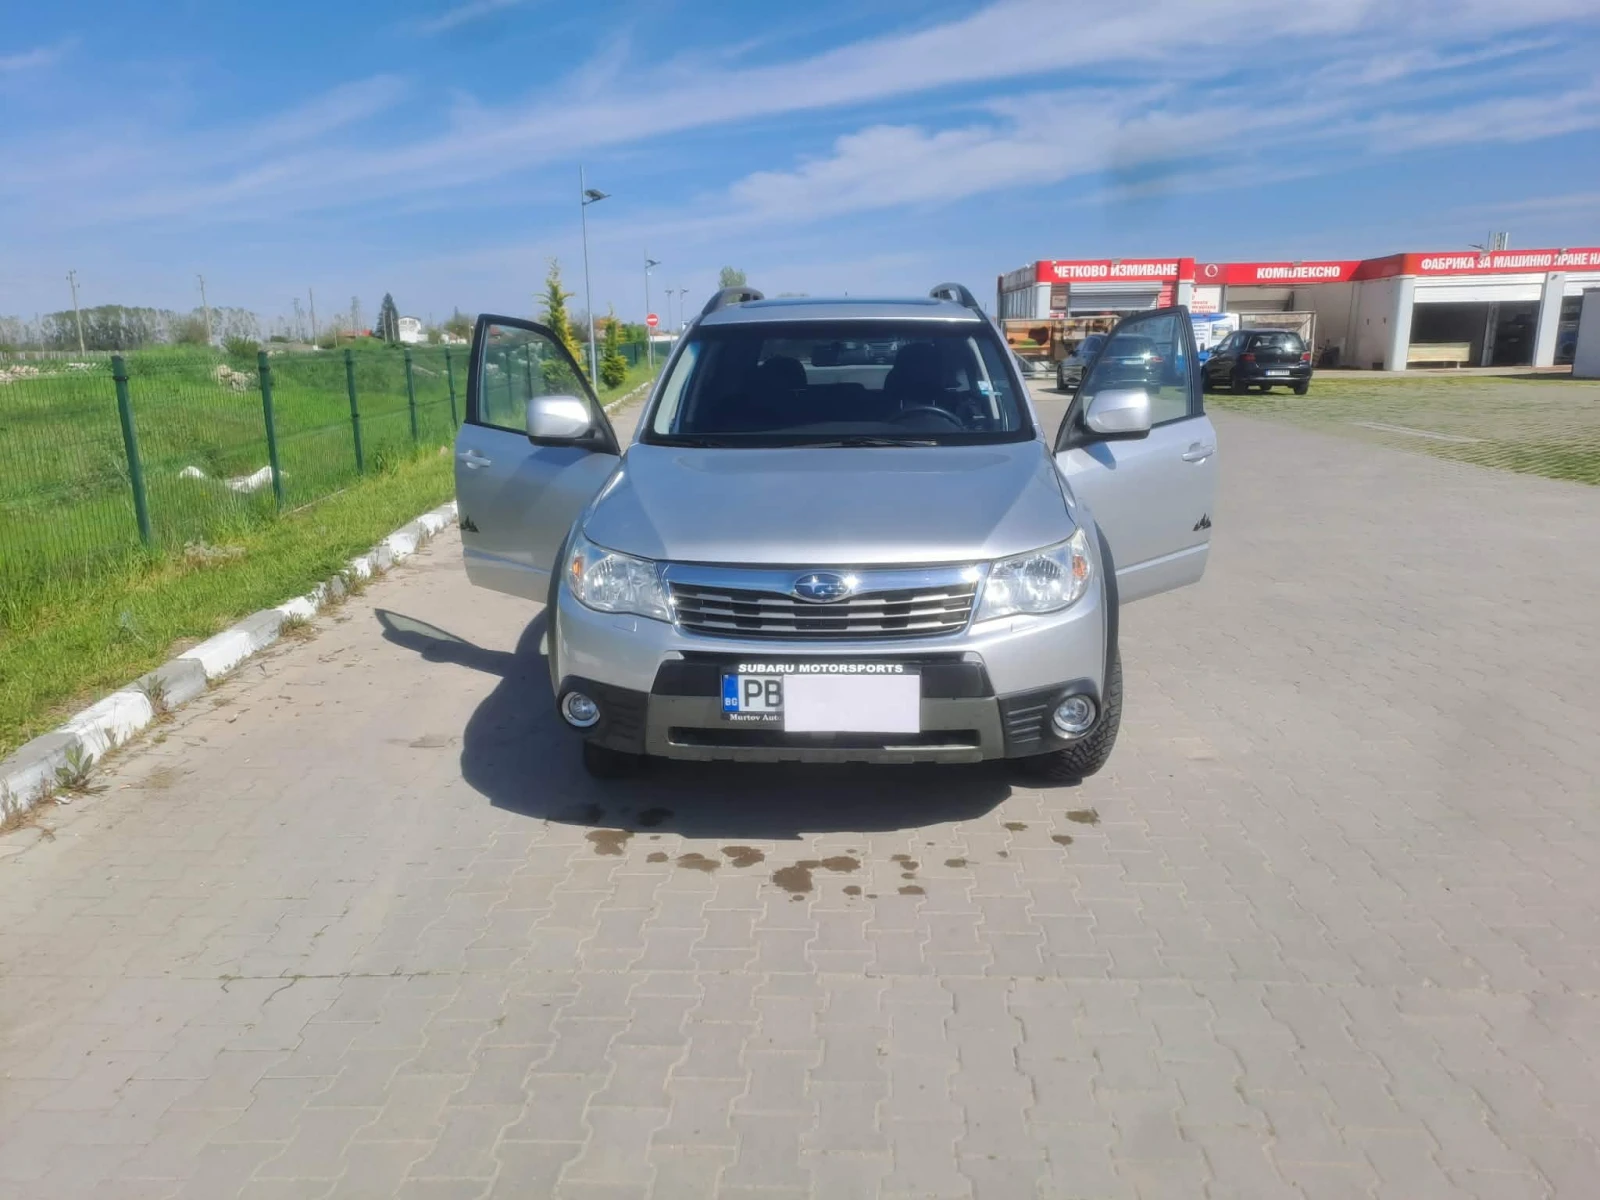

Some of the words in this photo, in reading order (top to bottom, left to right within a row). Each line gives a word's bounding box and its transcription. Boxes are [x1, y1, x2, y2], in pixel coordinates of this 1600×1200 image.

[1421, 257, 1474, 271] ФАБРИКА
[1477, 256, 1491, 269] ЗА
[1493, 254, 1551, 269] МАШИННО
[1054, 265, 1107, 277] ЧЕТКОВО
[1110, 264, 1177, 276] ИЗМИВАНЕ
[1256, 266, 1340, 279] КОМПЛЕКСНО
[738, 664, 795, 673] SUBARU
[799, 664, 903, 673] MOTORSPORTS
[725, 697, 738, 706] BG
[729, 713, 760, 721] Murtov
